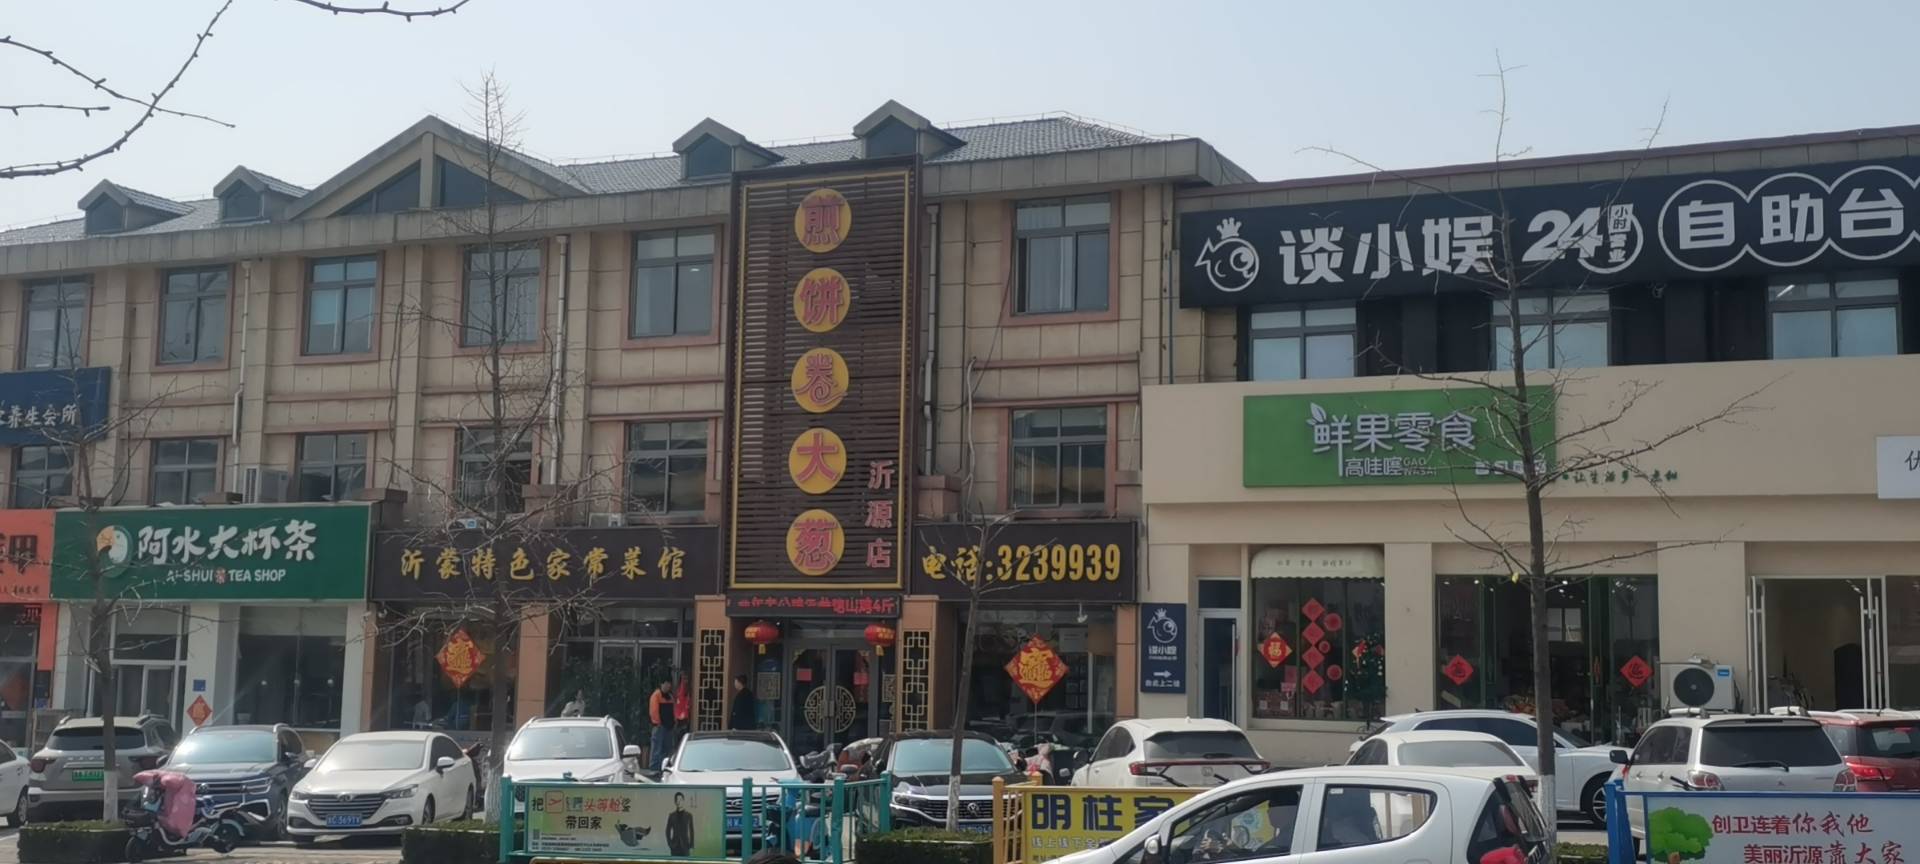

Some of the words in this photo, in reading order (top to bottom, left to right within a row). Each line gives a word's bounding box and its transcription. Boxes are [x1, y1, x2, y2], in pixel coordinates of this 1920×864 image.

[1522, 207, 1603, 264] 24
[1678, 188, 1905, 250] 自助台
[1279, 214, 1494, 285] 谈小娱
[795, 194, 848, 570] 煎饼卷大葱
[1311, 409, 1478, 477] 鲜果零食
[1403, 456, 1427, 467] GAO
[865, 460, 897, 569] 沂源店
[138, 519, 318, 565] 阿水大杯茶
[228, 568, 252, 582] TEA
[254, 568, 287, 582] SHOP
[400, 546, 688, 581] 沂蒙特色家常菜馆
[566, 815, 602, 831] 带回家
[1031, 794, 1176, 832] 明柱家
[1712, 811, 1874, 836] 创卫连着你我他
[1744, 840, 1906, 864] 美丽沂源靠大家
